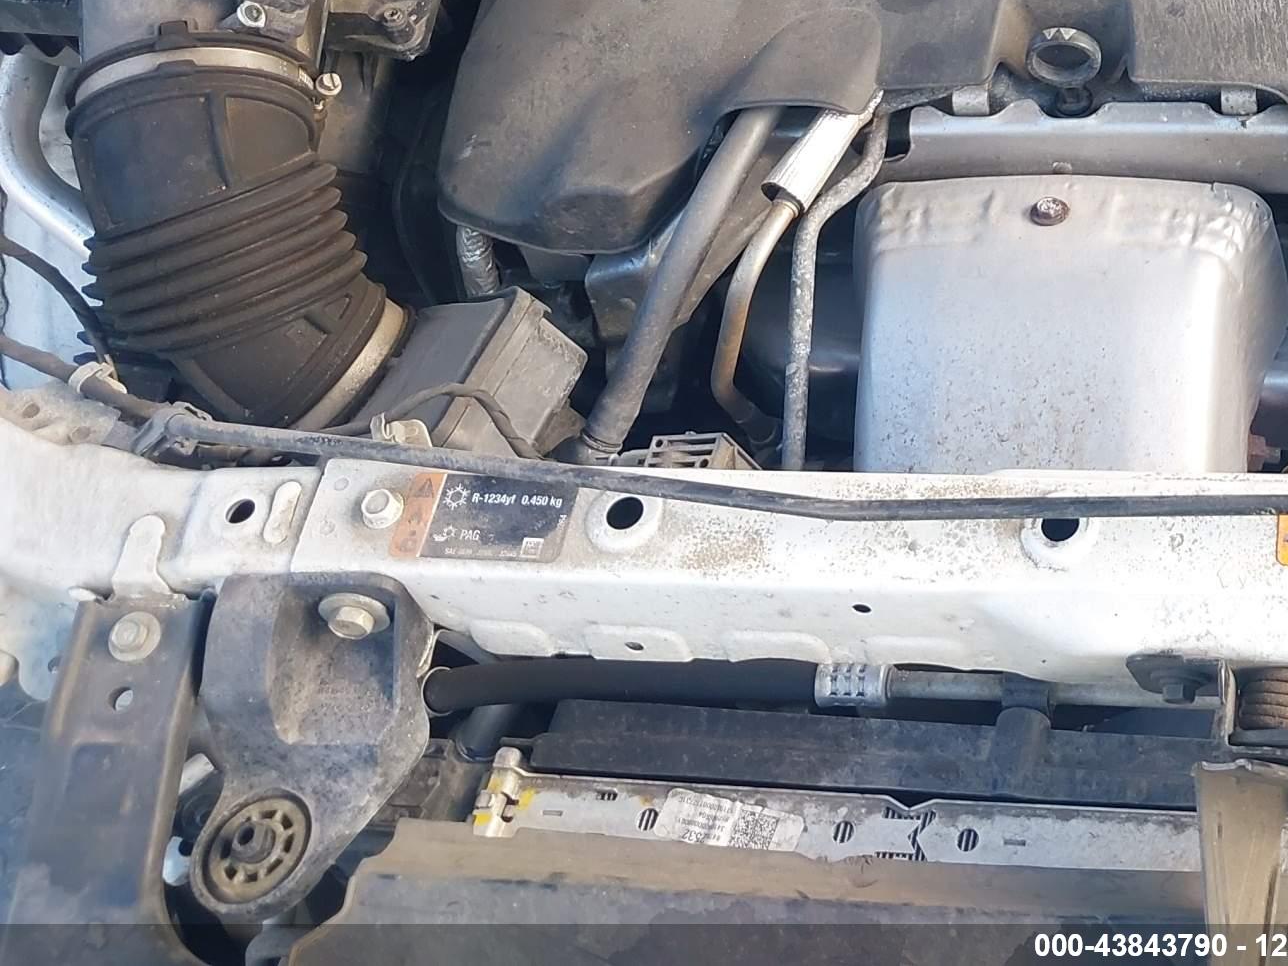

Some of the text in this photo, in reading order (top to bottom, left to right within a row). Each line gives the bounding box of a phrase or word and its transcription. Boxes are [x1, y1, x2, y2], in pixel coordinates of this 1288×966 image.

[471, 491, 563, 508] R-1234yf 0.450 kg
[459, 528, 481, 542] PAG
